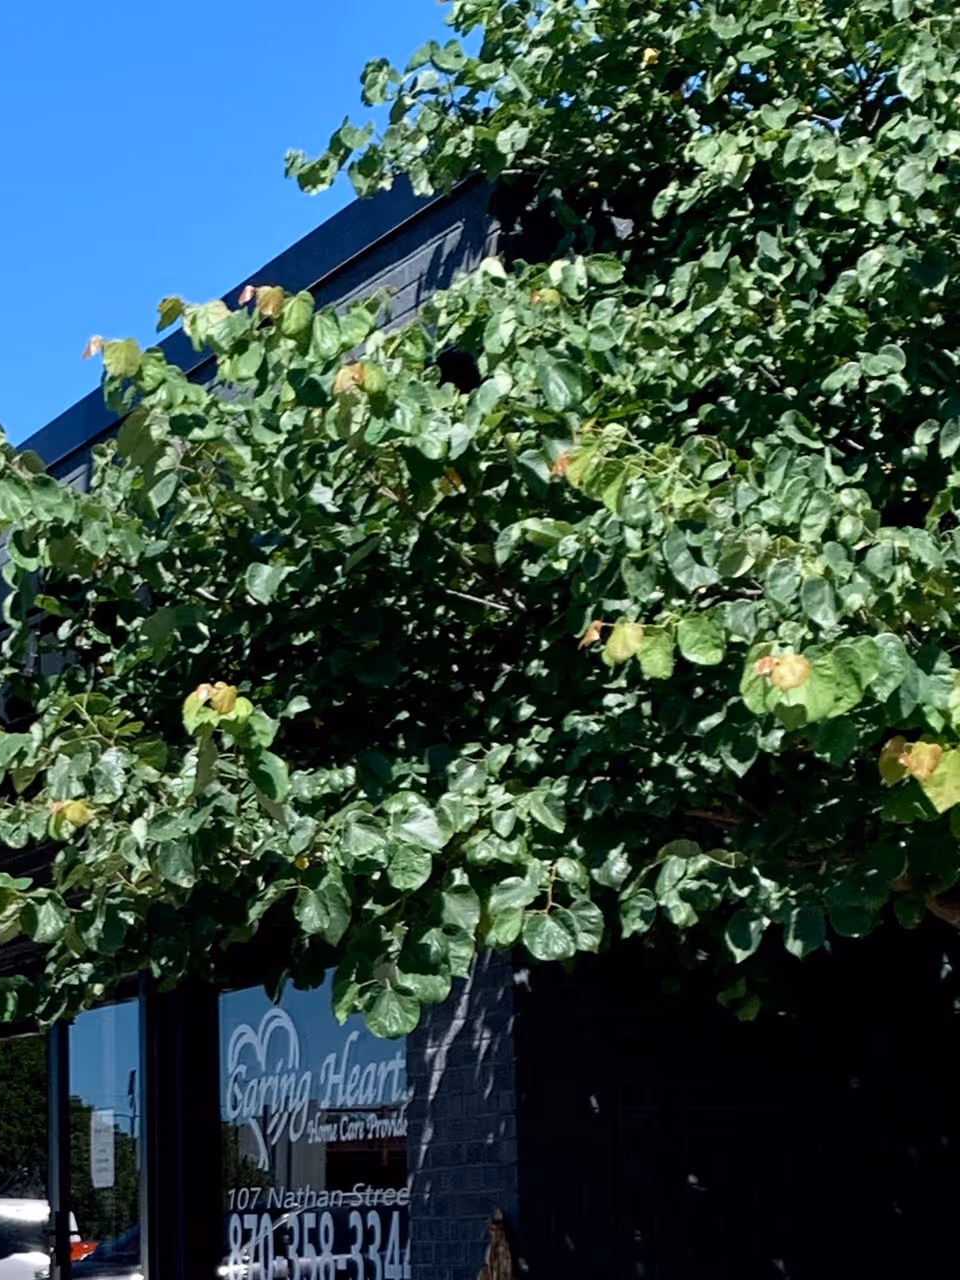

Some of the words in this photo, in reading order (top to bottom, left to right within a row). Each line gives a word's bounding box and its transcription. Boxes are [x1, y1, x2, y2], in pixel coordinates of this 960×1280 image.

[227, 1059, 311, 1142] Caring
[320, 1031, 408, 1109] Heart
[308, 1112, 337, 1144] Home
[340, 1117, 364, 1141] Care
[368, 1110, 408, 1138] Provide
[228, 1187, 261, 1210] 107
[267, 1184, 343, 1209] Nathan
[350, 1183, 411, 1207] Stree
